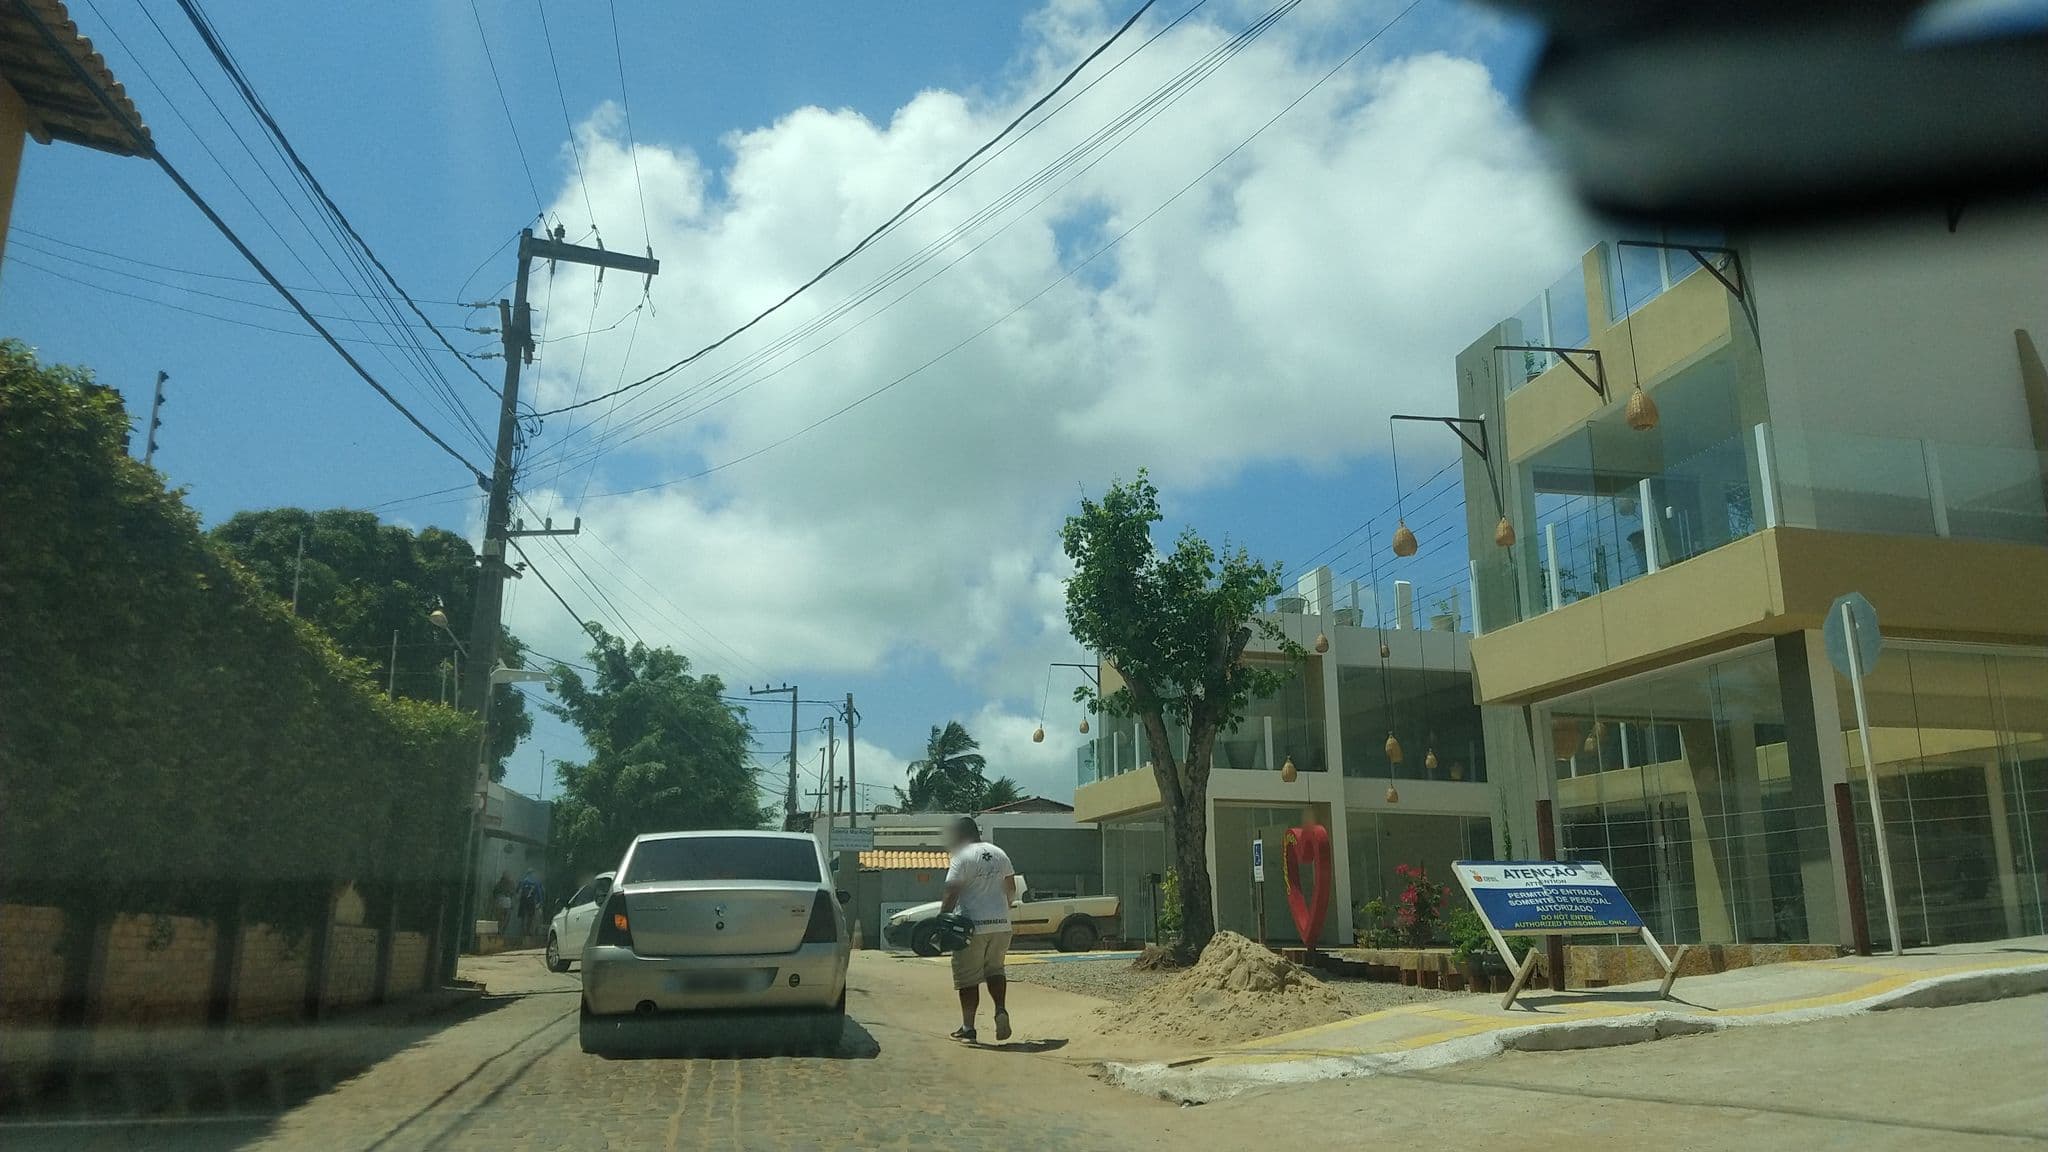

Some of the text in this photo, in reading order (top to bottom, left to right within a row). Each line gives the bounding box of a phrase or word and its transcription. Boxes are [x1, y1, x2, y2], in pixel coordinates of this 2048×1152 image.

[1503, 866, 1578, 879] ATENÇÃO
[1507, 888, 1603, 899] PERMITIDO ENTRADA
[1508, 896, 1555, 906] SOMENTE
[1569, 896, 1612, 905] PESSOAL
